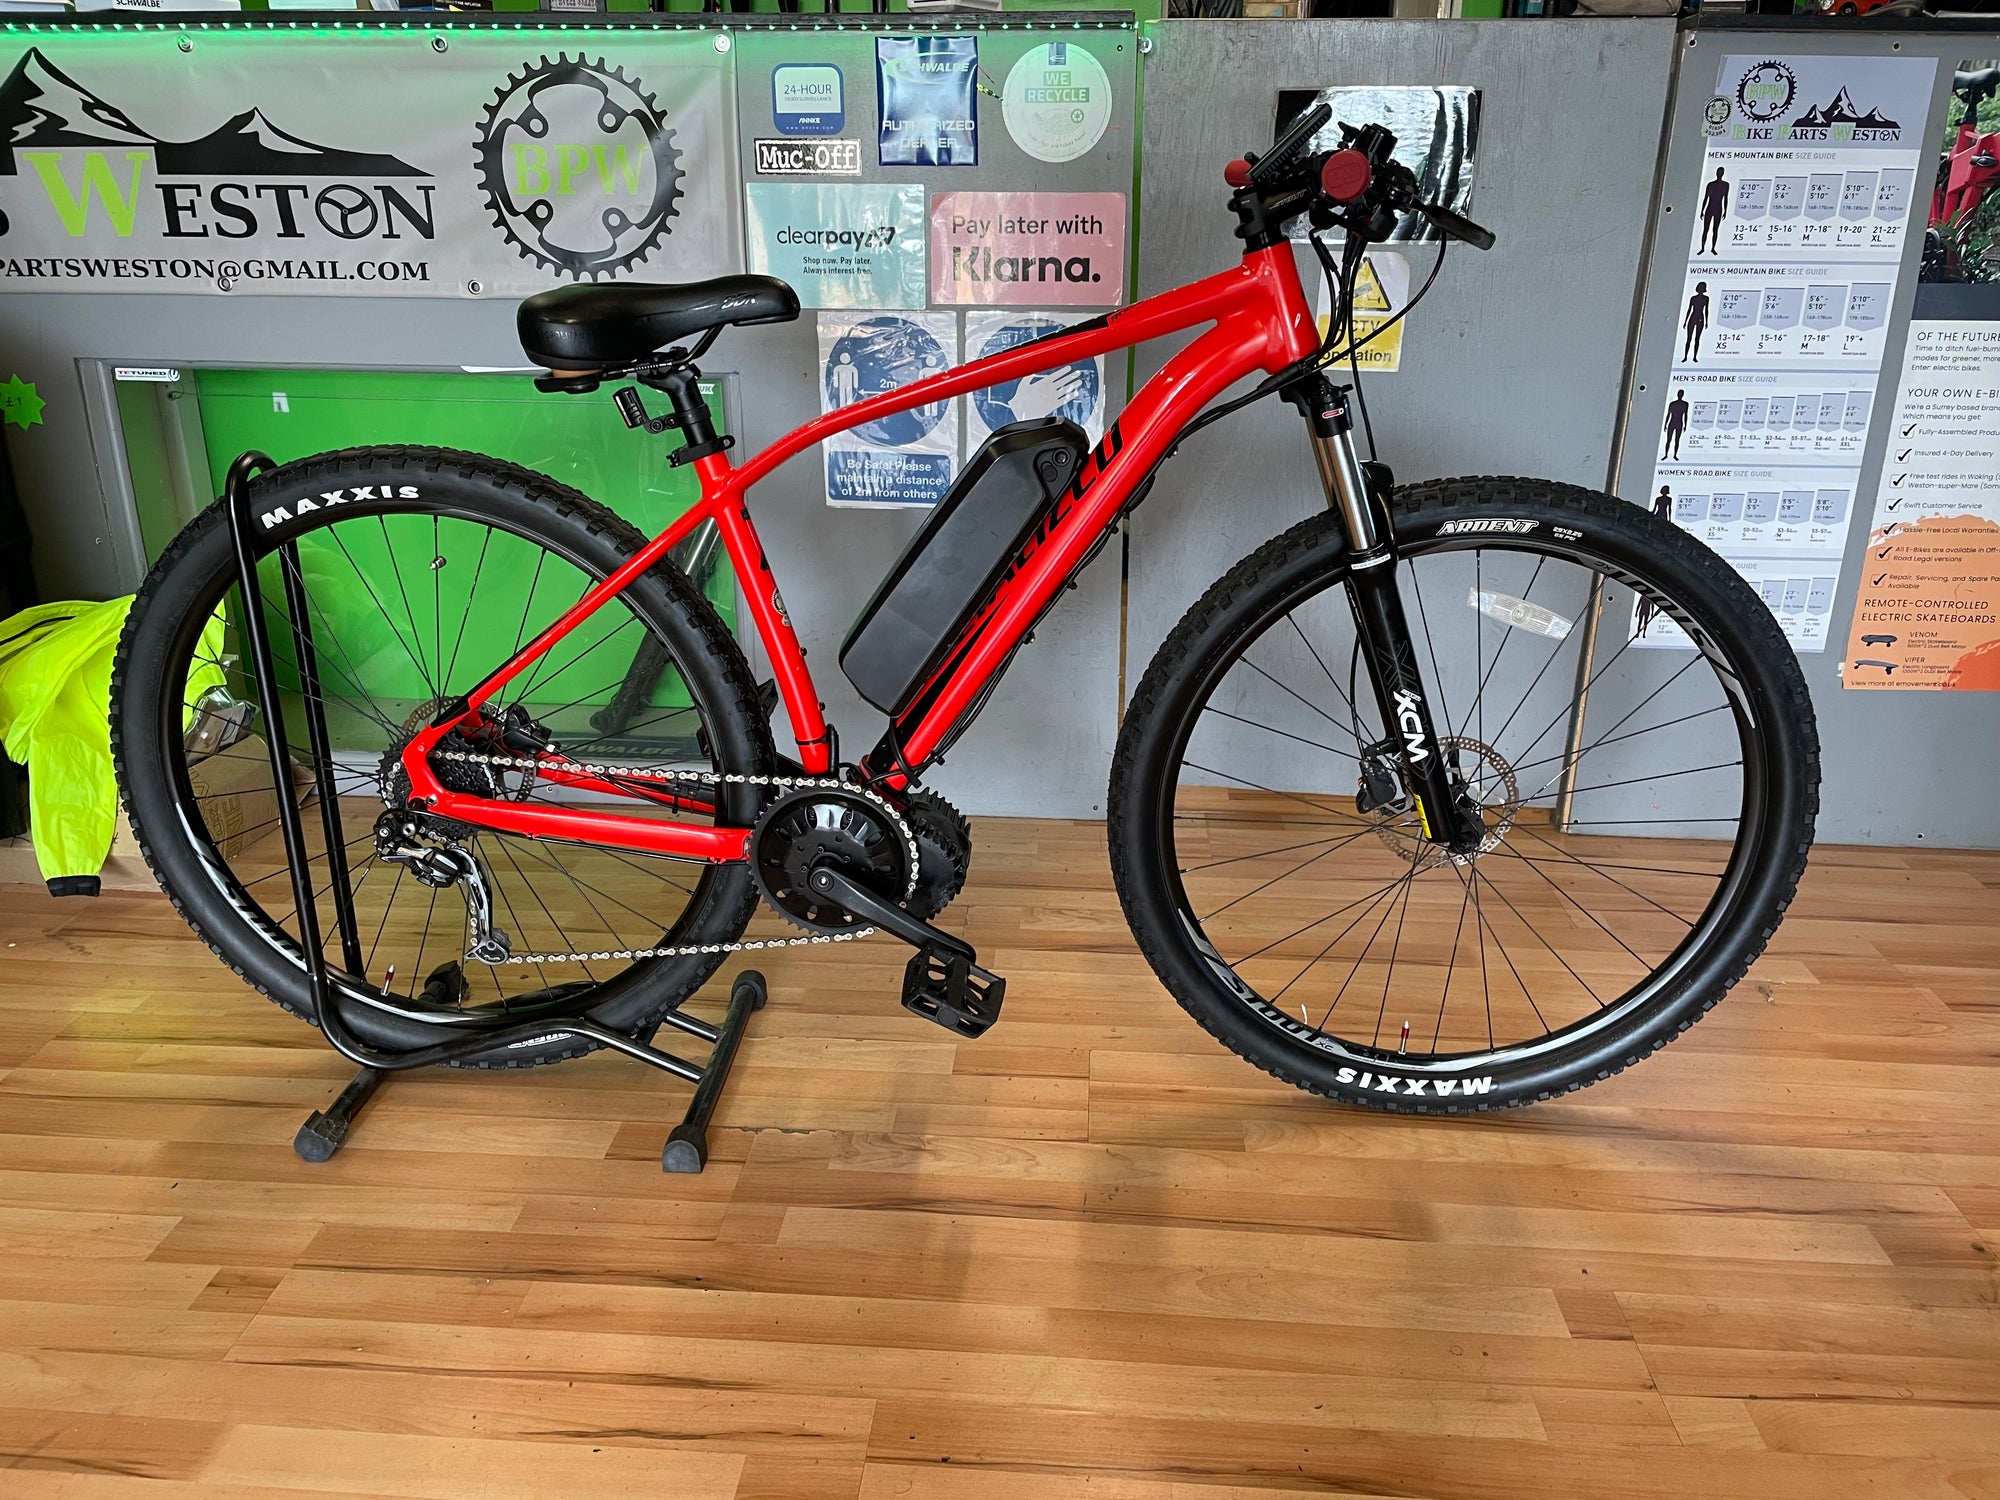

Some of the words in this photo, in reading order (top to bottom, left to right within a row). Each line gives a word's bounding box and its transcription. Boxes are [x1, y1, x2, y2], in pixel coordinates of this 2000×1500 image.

[897, 62, 970, 72] HWALBE
[1046, 72, 1069, 85] WE
[784, 84, 832, 95] 24-HOUR
[1746, 84, 1786, 100] BPW
[1028, 89, 1087, 101] RECYCLE
[1732, 124, 1774, 140] BIKE
[1777, 124, 1828, 140] PARTS
[1832, 124, 1901, 141] WESTON
[901, 137, 957, 148] DEAER
[760, 140, 857, 170] Muc-Off
[1708, 151, 1732, 159] MEN'S
[1733, 151, 1774, 159] MOUNTAIN
[1775, 151, 1794, 159] BIKE
[1795, 152, 1812, 160] SIZE
[1813, 152, 1837, 160] GUIDE
[508, 143, 649, 196] BPW
[22, 152, 436, 240] WESTON
[952, 215, 992, 238] Pay
[998, 214, 1049, 236] later
[1055, 214, 1103, 236] with
[1735, 225, 1763, 233] 13-14"
[1769, 225, 1797, 233] 15-16"
[1804, 225, 1832, 233] 17-18"
[1839, 225, 1867, 234] 19-20"
[1872, 226, 1901, 234] 21-22"
[776, 225, 865, 252] clearpay
[1732, 233, 1744, 241] XS
[1767, 233, 1773, 241] S
[1837, 234, 1842, 242] L
[1871, 234, 1882, 242] XL
[803, 256, 821, 265] Shop
[840, 257, 853, 266] Pay
[854, 256, 872, 265] later.
[952, 247, 1102, 283] Klarna.
[0, 258, 430, 282] ARTSWESTON@GMAIL.COM
[803, 266, 827, 275] Always
[1689, 267, 1726, 275] WOMEN'S
[1726, 267, 1767, 275] MOUNTAIN
[1805, 268, 1828, 276] GUIDE
[1917, 331, 1934, 341] OF
[1937, 331, 1959, 342] THE
[1962, 331, 2000, 342] FUTURE
[1715, 342, 1727, 350] XS
[1758, 342, 1764, 350] S
[1801, 342, 1809, 350] M
[1843, 343, 1849, 351] L
[1915, 344, 1933, 352] Time
[1321, 349, 1392, 363] opation
[1912, 354, 1939, 362] modes
[1940, 354, 1951, 362] for
[879, 378, 897, 389] 2m
[1907, 388, 1939, 398] YOUR
[1942, 388, 1973, 398] OWN
[1932, 403, 1955, 412] Surrey
[1902, 412, 1925, 420] Which
[1918, 428, 1978, 436] Fully-Assembled
[1914, 449, 1941, 457] Insured
[1965, 450, 1994, 458] Delivery
[895, 460, 932, 472] Please
[1657, 469, 1692, 477] WOMEN'S
[1692, 469, 1714, 477] ROAD
[1750, 470, 1773, 478] GUIDE
[1967, 473, 1994, 482] Woking
[895, 475, 942, 486] distance
[1907, 482, 1979, 490] Weston-super-Mare
[841, 487, 852, 496] of
[855, 487, 872, 497] 2m
[875, 488, 900, 498] from
[903, 488, 938, 500] others
[260, 484, 421, 531] MAXXIS
[1435, 518, 1540, 537] ARDENT
[1913, 555, 1933, 563] Legal
[1864, 598, 1990, 610] REMOTE-CONTROLLED
[1861, 612, 1912, 622] ELECTRIC
[1916, 613, 1997, 624] SKATEBOARDS
[1392, 690, 1429, 764] XCM
[1221, 974, 1322, 1043] STOUT
[1335, 1066, 1493, 1097] MAXXIS
